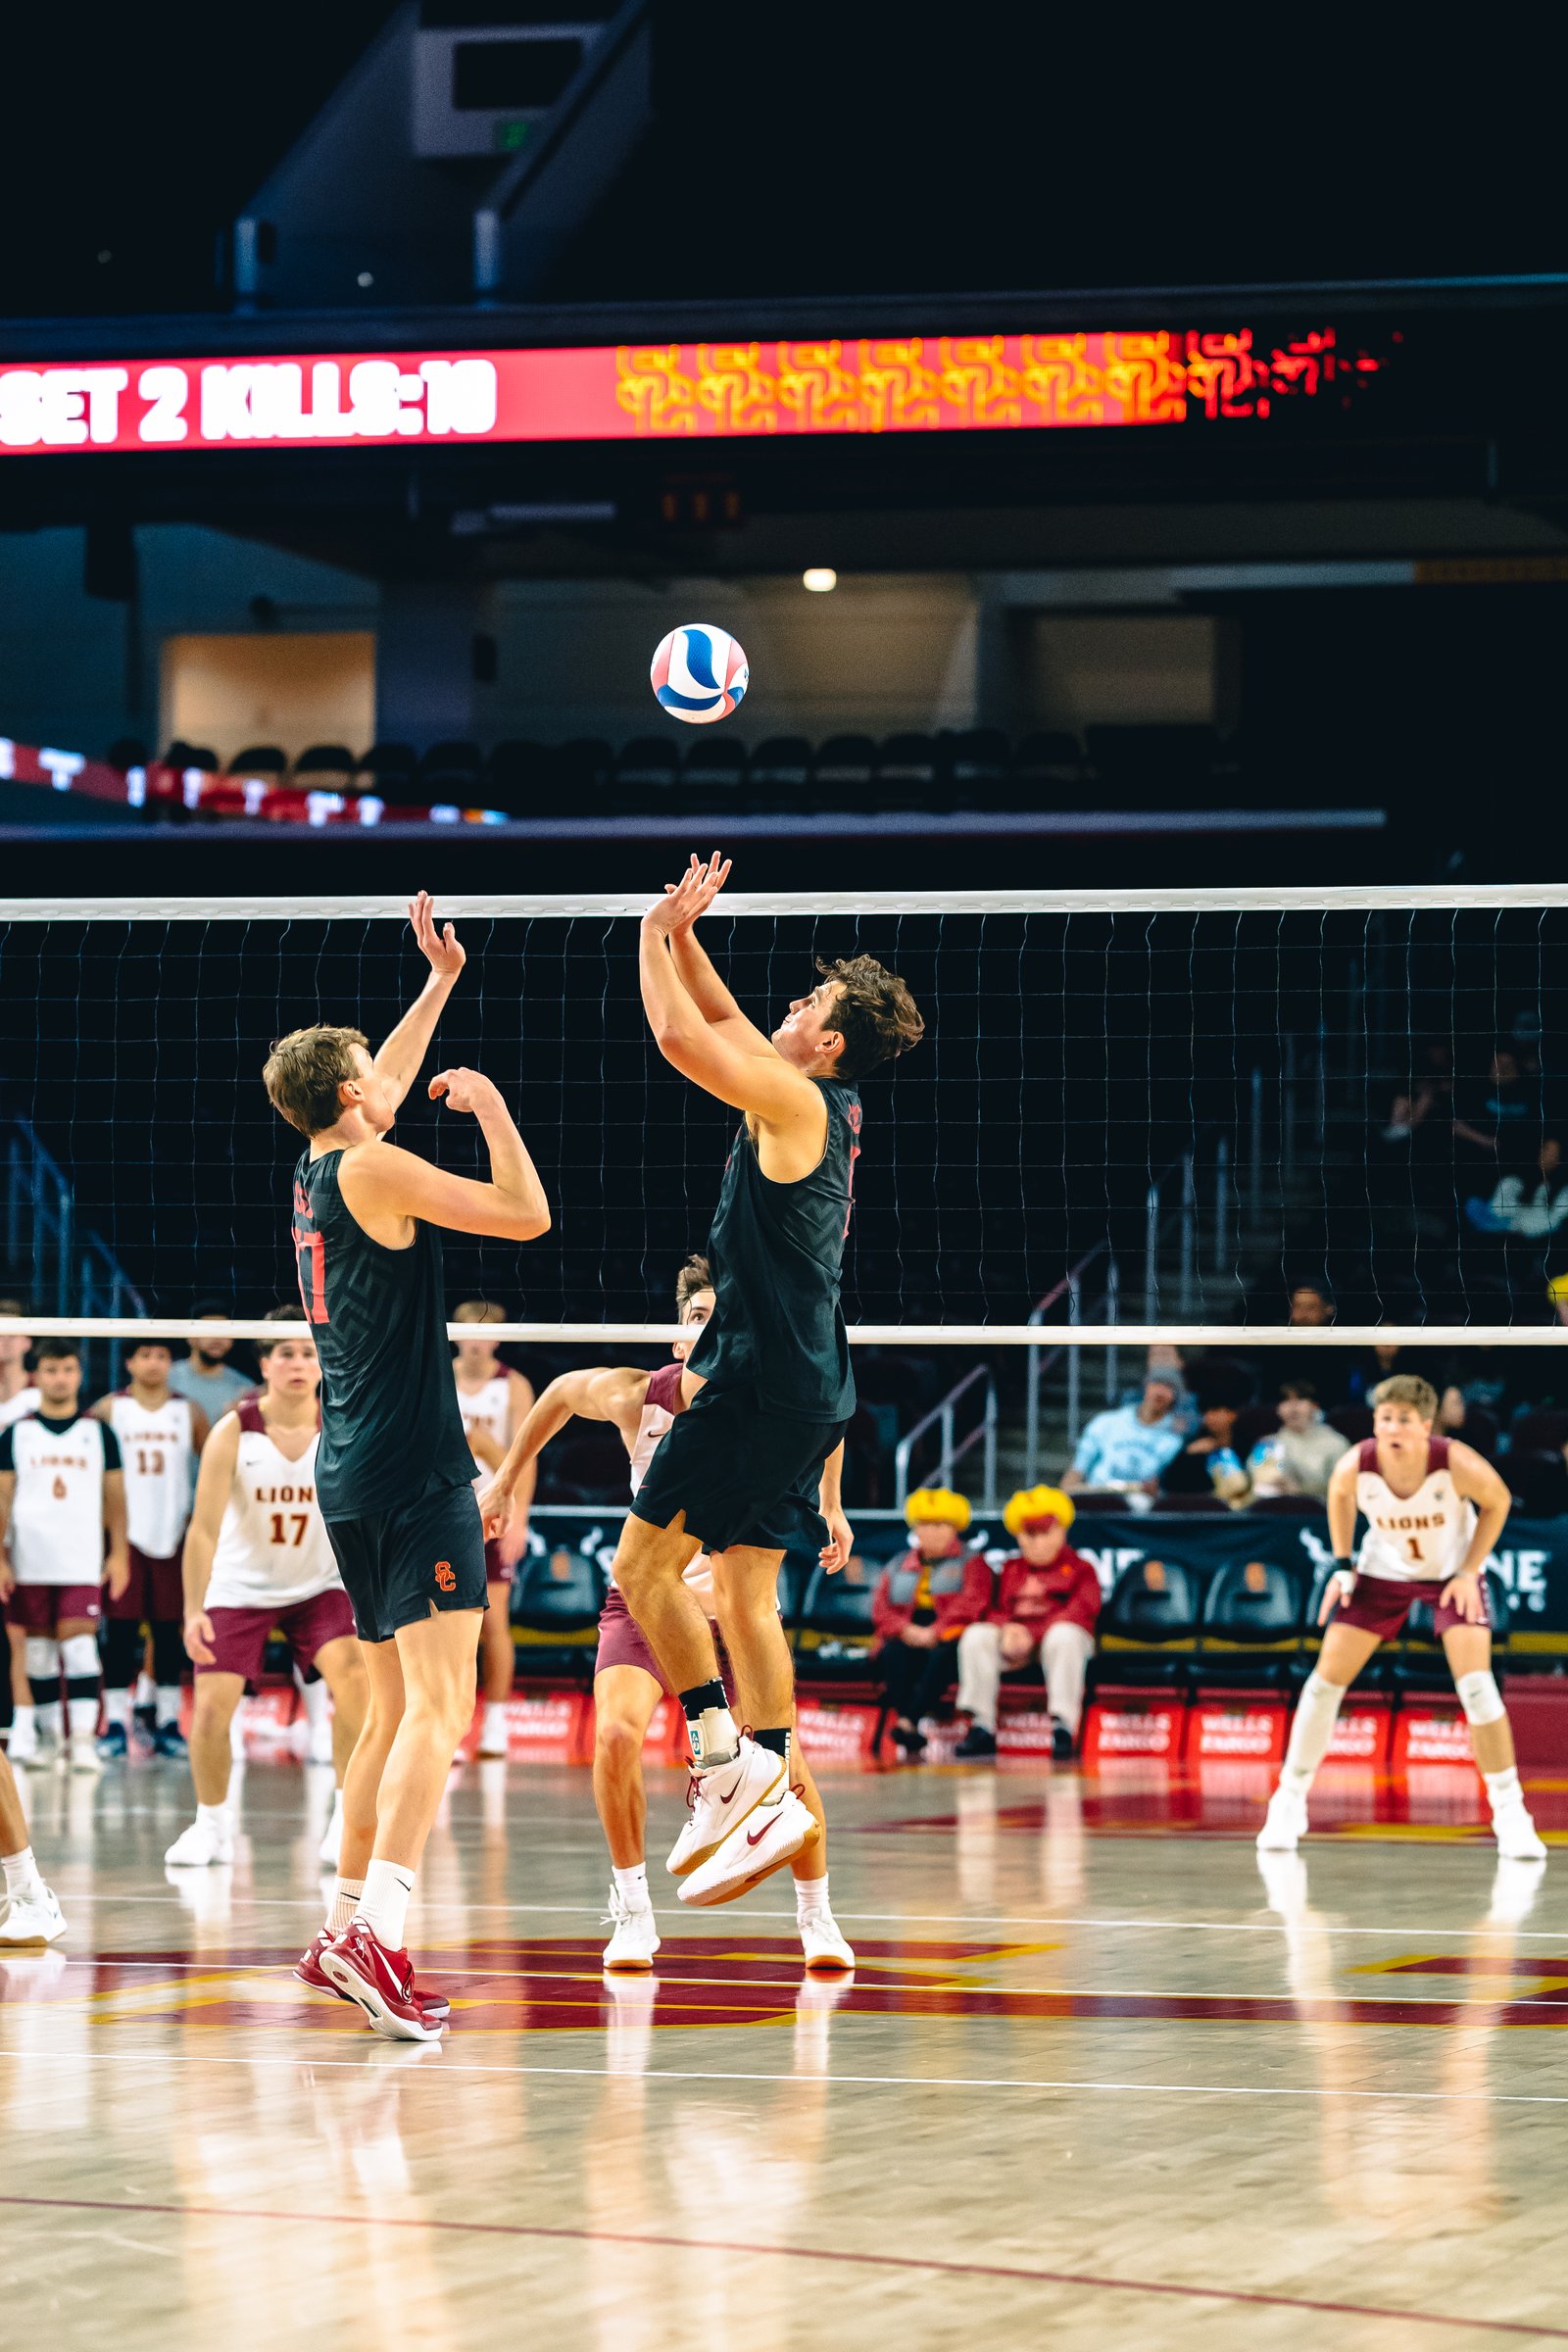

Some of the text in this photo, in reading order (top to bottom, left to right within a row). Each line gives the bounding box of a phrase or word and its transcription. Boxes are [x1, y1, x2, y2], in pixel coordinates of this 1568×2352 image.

[0, 367, 128, 446] SET
[138, 367, 188, 442] 2
[255, 1486, 314, 1502] LION
[270, 1512, 309, 1547] 17
[1376, 1513, 1446, 1531] LIONS
[1407, 1537, 1425, 1561] 1
